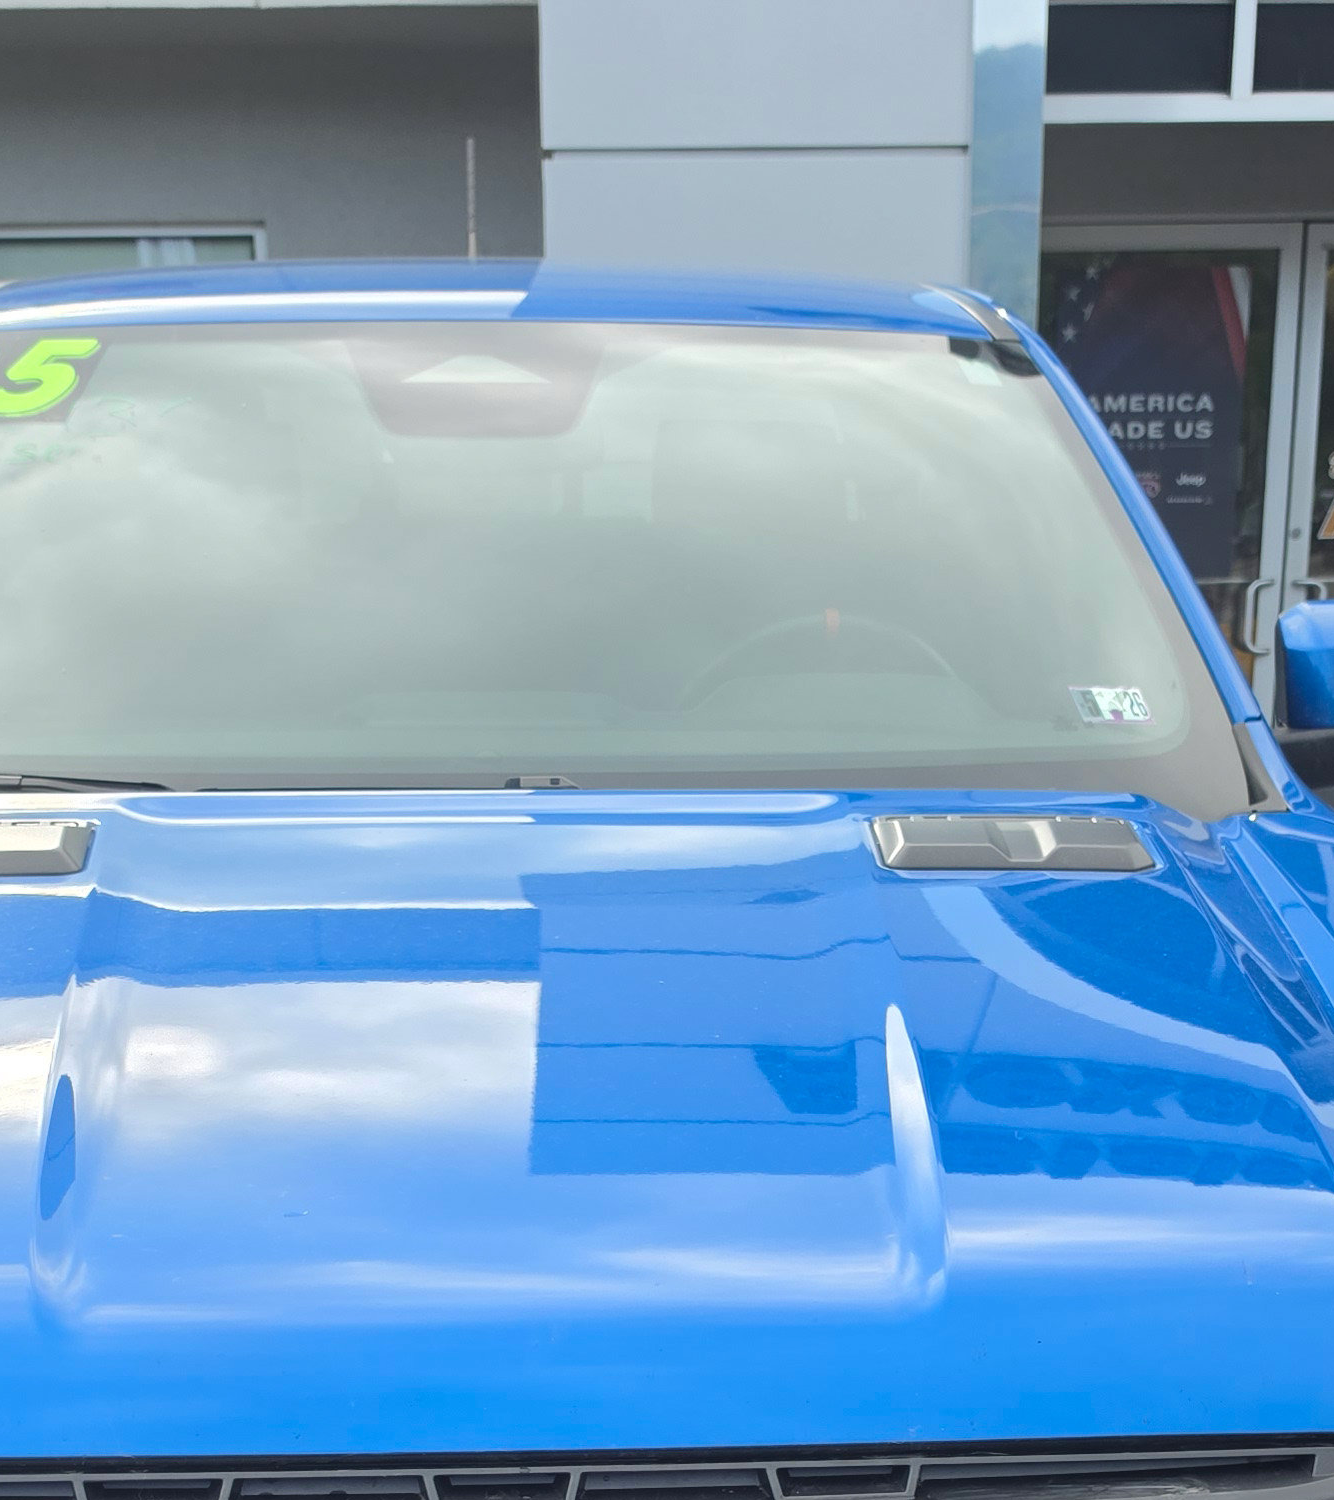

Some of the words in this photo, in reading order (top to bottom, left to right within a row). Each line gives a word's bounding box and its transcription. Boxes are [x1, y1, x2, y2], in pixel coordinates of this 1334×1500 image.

[1088, 392, 1214, 413] AMERICA
[1108, 420, 1165, 440] ADE
[1174, 420, 1214, 440] US
